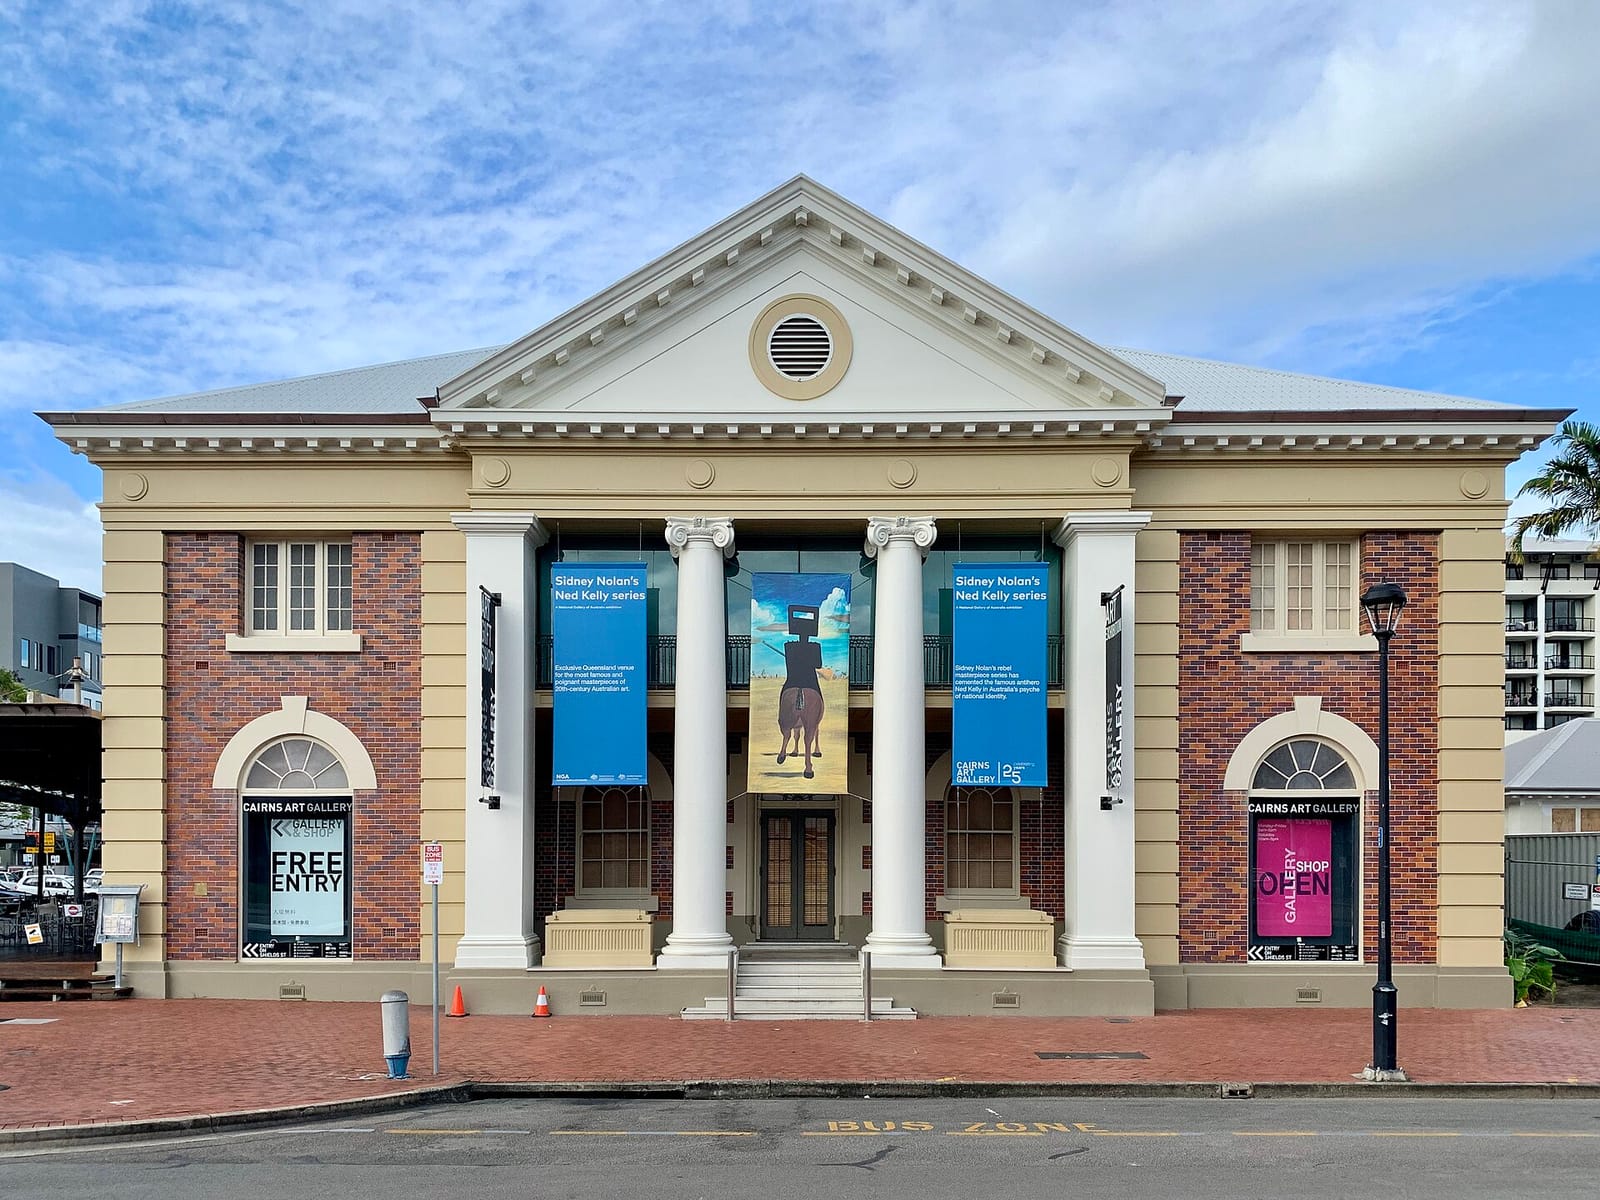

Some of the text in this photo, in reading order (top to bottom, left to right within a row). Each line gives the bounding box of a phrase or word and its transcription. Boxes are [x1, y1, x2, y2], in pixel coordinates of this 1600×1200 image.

[556, 576, 640, 588] Sidney Nolan's
[956, 576, 1041, 588] Sidney Nolan's
[556, 591, 646, 602] Ned Kelly series
[957, 591, 1047, 602] Ned Kelly series
[957, 776, 995, 784] GALLERY
[243, 803, 353, 812] CAIRNS ART GALLERY
[1248, 804, 1359, 813] CAIRNS ART GALLERY
[293, 820, 343, 829] GALLERY
[303, 829, 335, 837] SHOP
[272, 852, 343, 874] FREE
[1296, 861, 1329, 872] SHOP
[272, 874, 342, 892] ENTRY
[1284, 847, 1297, 923] GALLERY
[828, 1121, 1109, 1133] BUS ZONE
